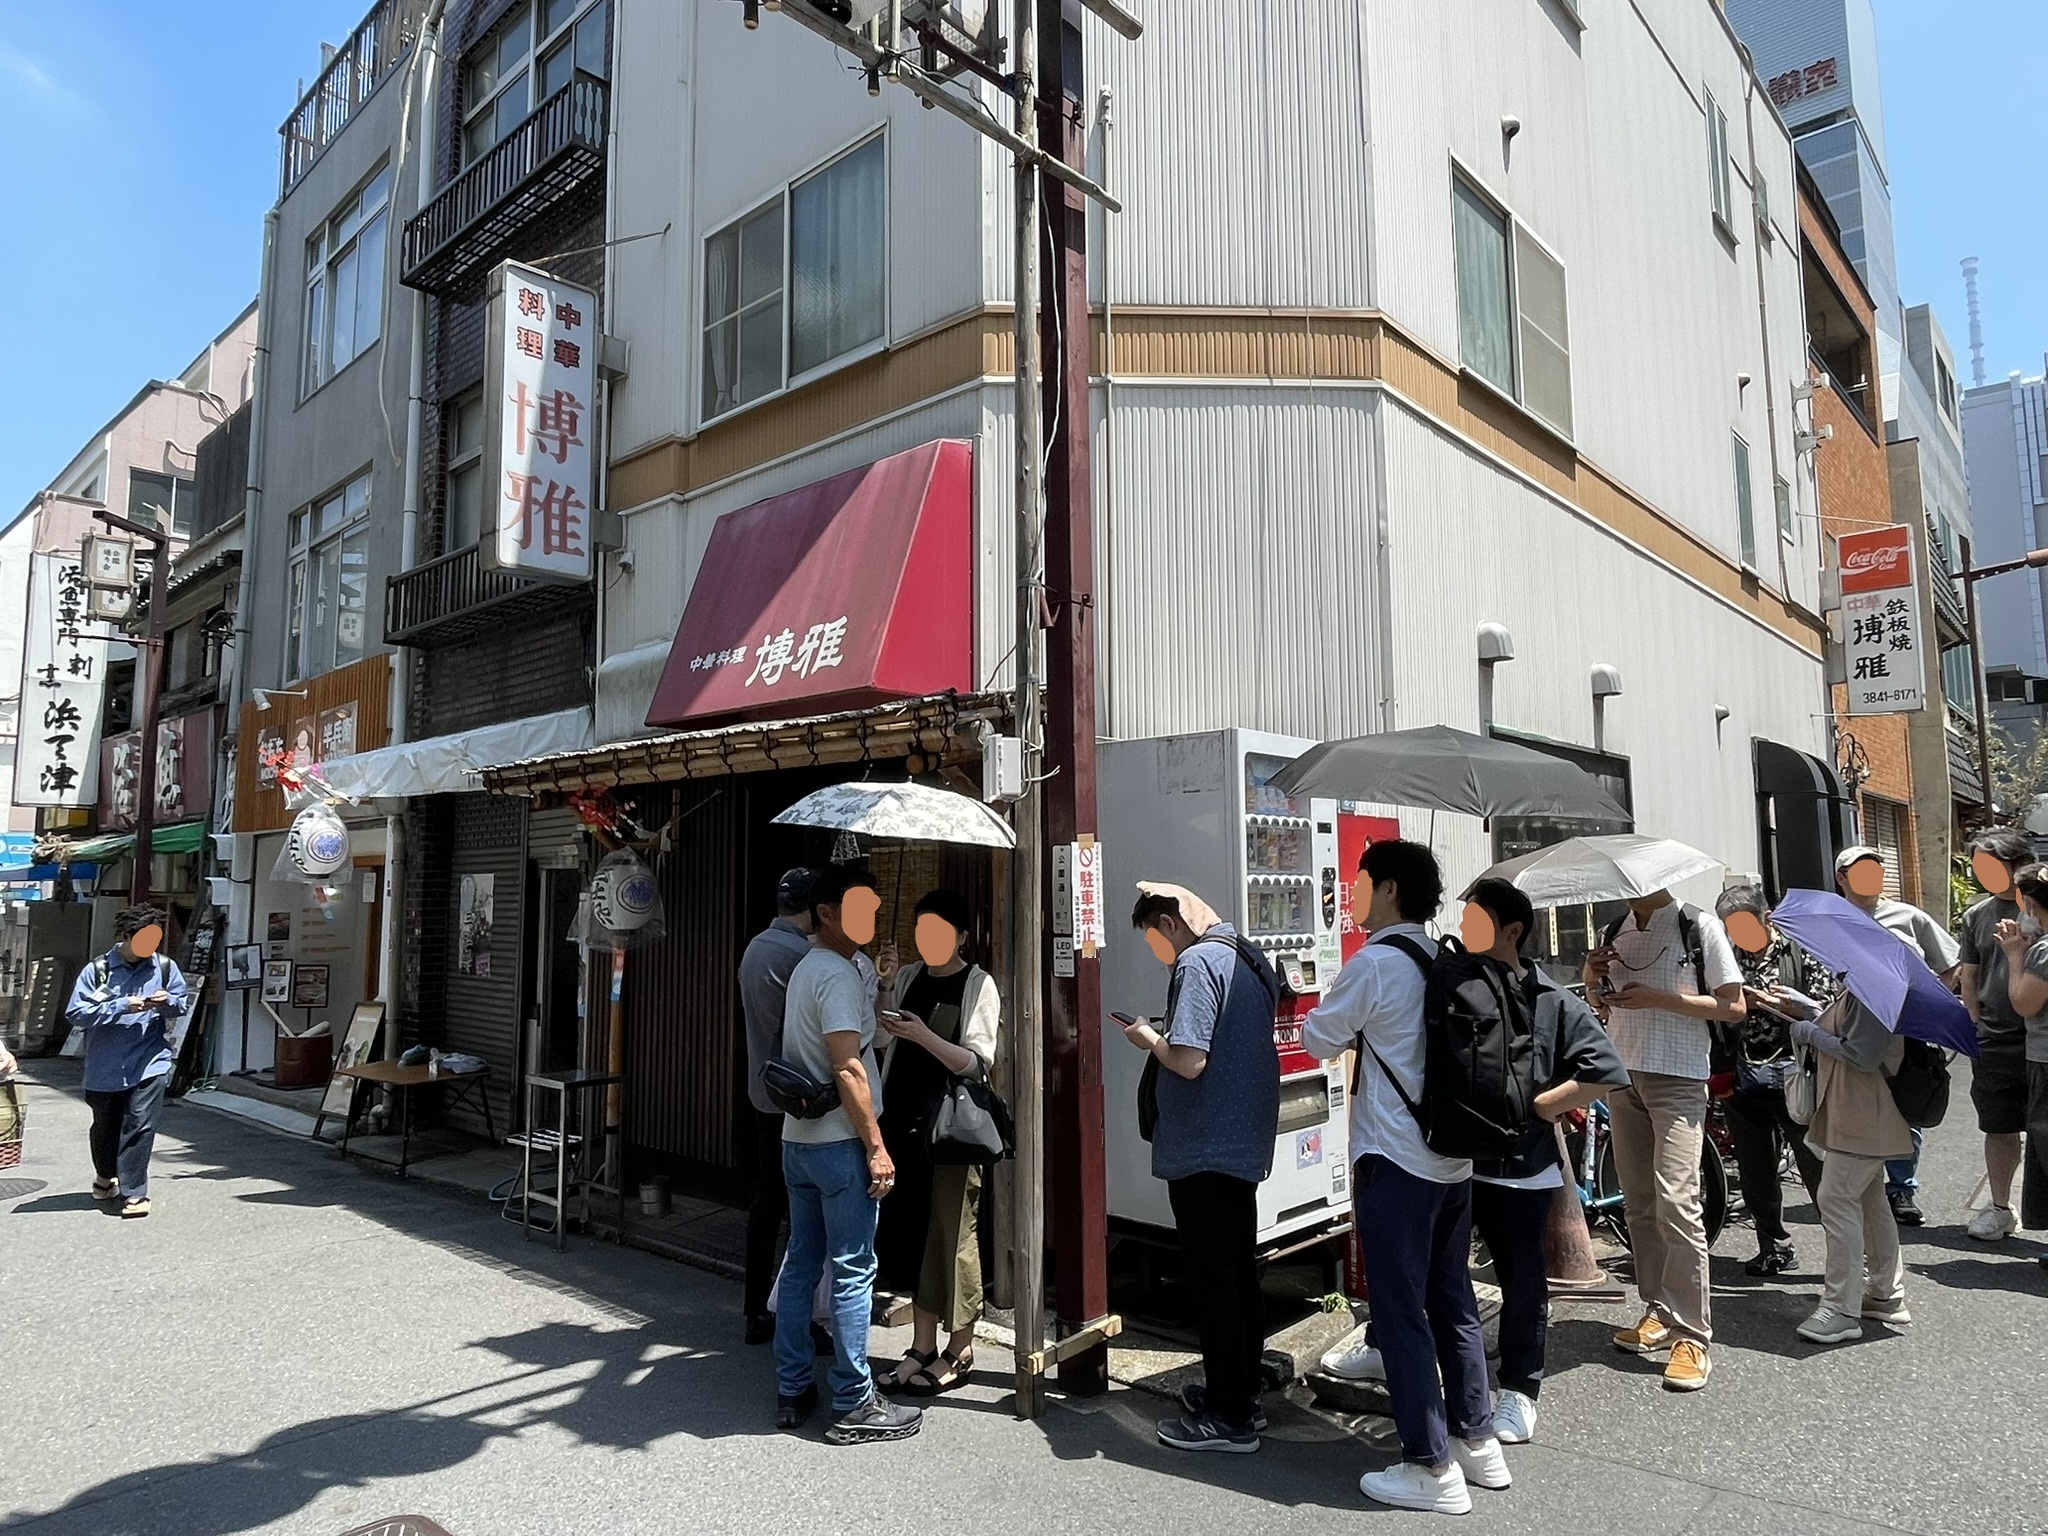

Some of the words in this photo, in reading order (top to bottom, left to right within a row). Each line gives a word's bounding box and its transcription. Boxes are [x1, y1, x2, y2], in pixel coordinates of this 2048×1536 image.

[516, 288, 546, 359] 料理
[555, 303, 582, 370] 中華
[503, 380, 586, 558] 博雅
[1847, 593, 1881, 613] 中華
[1885, 598, 1913, 653] 鉄板焼
[689, 643, 748, 673] 中華料理
[744, 615, 848, 688] 博雅
[1853, 613, 1891, 681] 博雅
[1862, 688, 1917, 705] 3841-6171
[1079, 870, 1096, 943] 駐車禁止
[1056, 941, 1071, 951] LED
